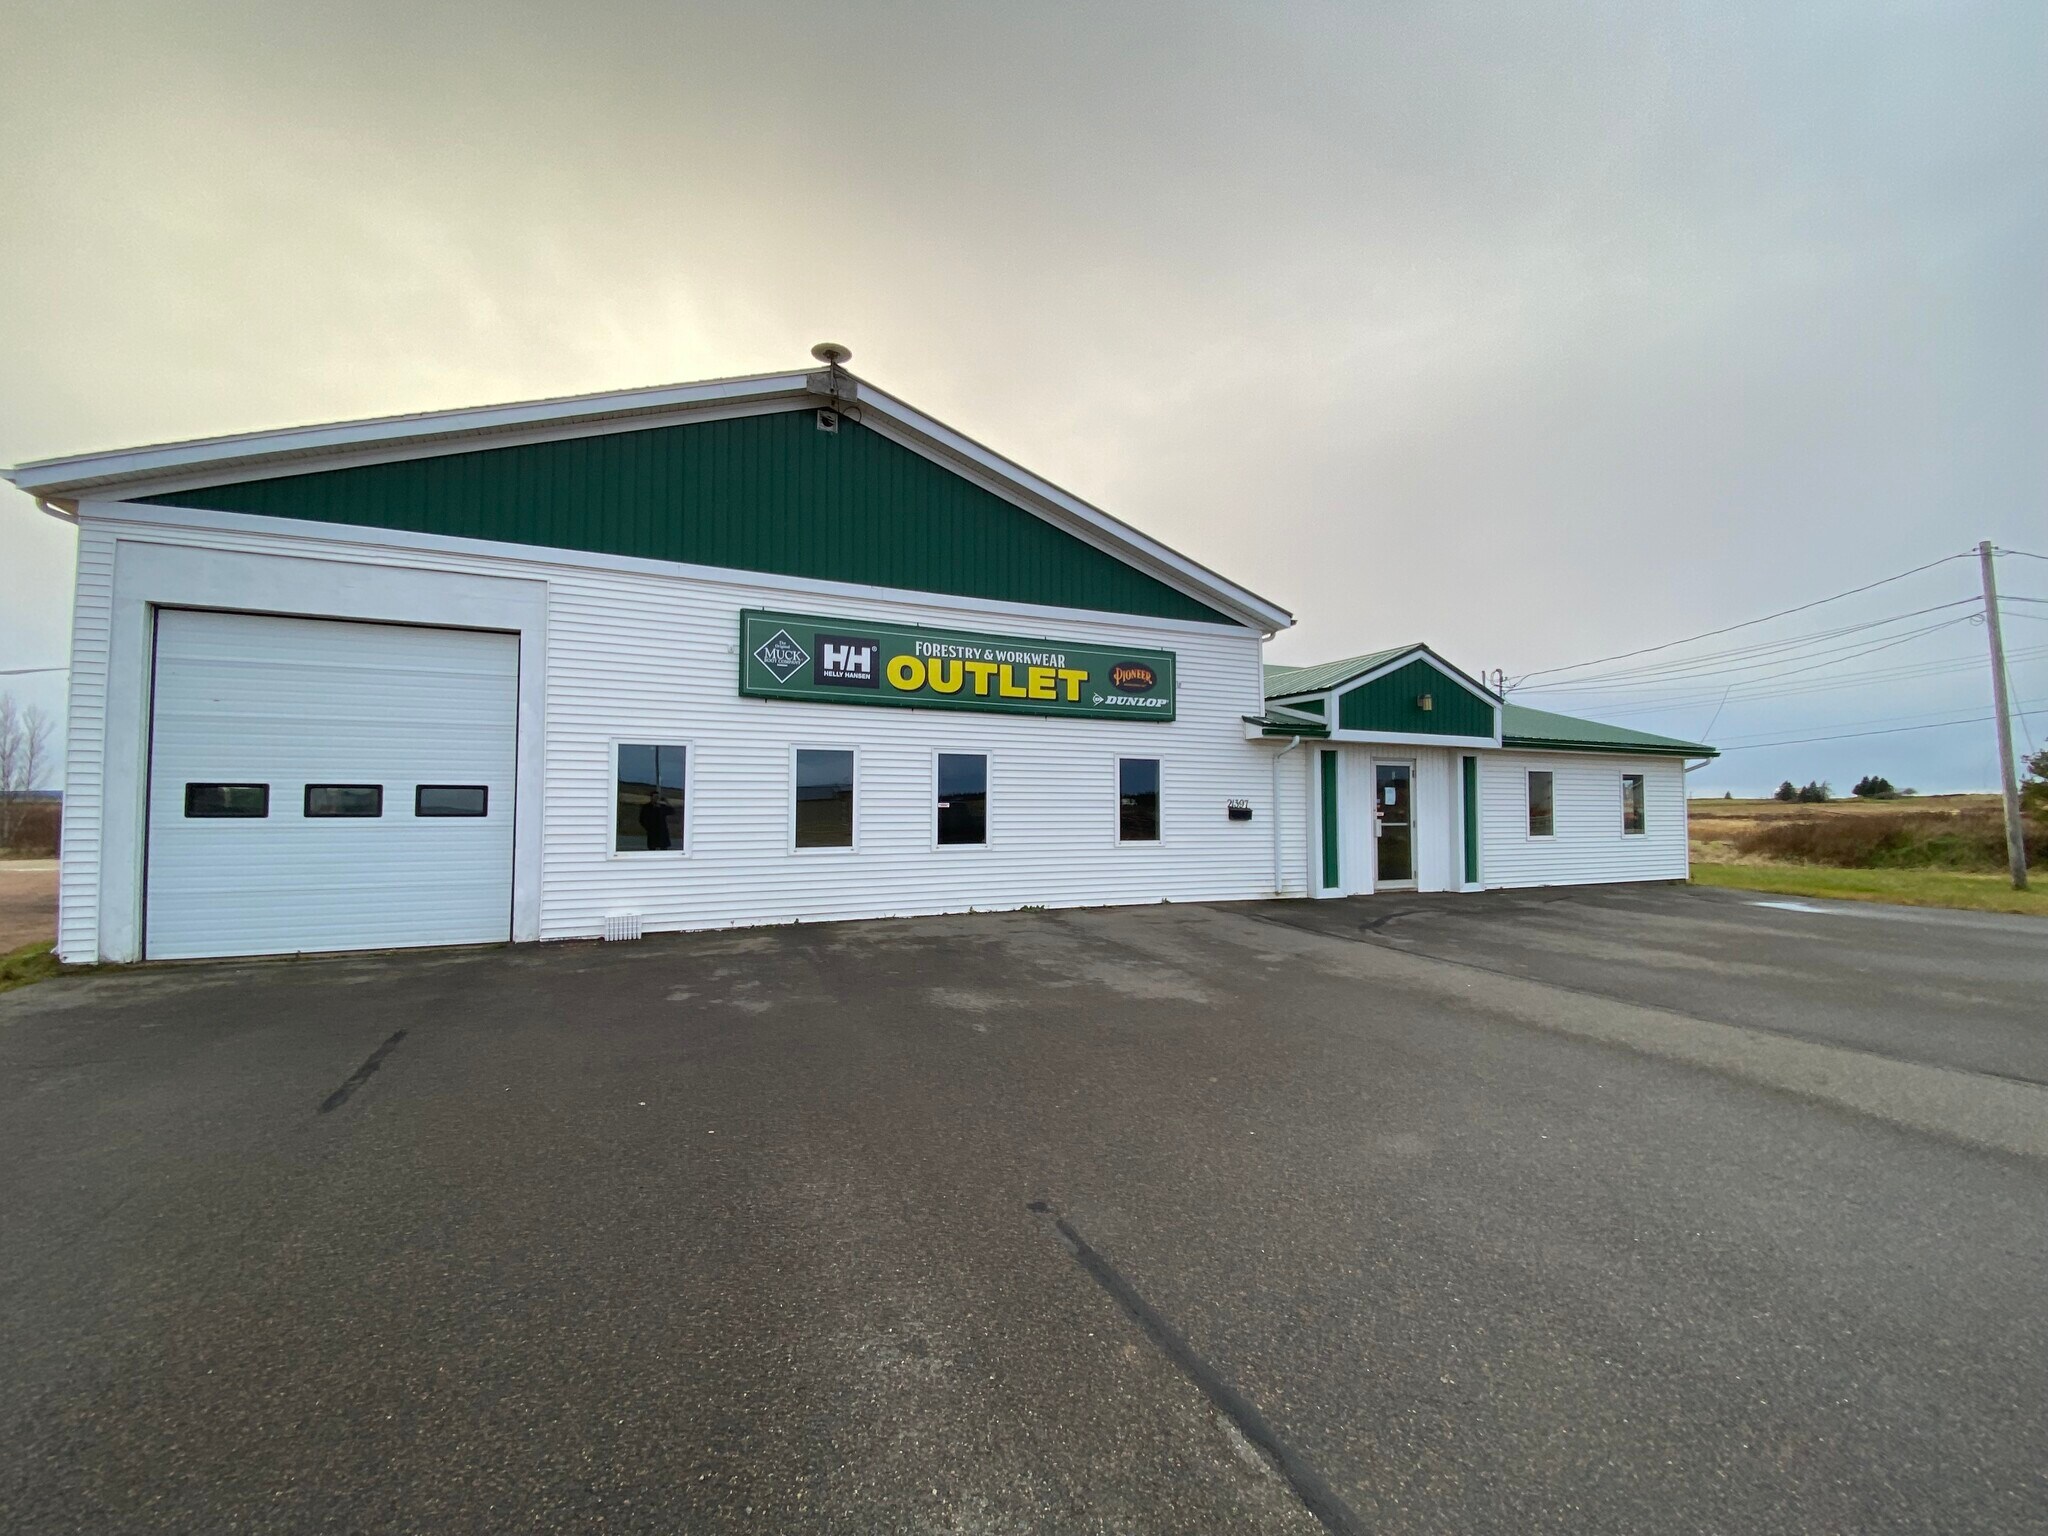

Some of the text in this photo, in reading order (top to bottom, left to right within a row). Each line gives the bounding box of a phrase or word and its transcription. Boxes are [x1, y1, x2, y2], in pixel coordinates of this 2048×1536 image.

[764, 647, 801, 661] MUCK
[915, 641, 1066, 668] FORESTRY & WORKWEAR
[823, 670, 871, 680] HELLY HANSEN
[886, 655, 1089, 702] OUTLET
[1113, 667, 1153, 687] PIONEER
[1104, 695, 1167, 708] DUNLOP
